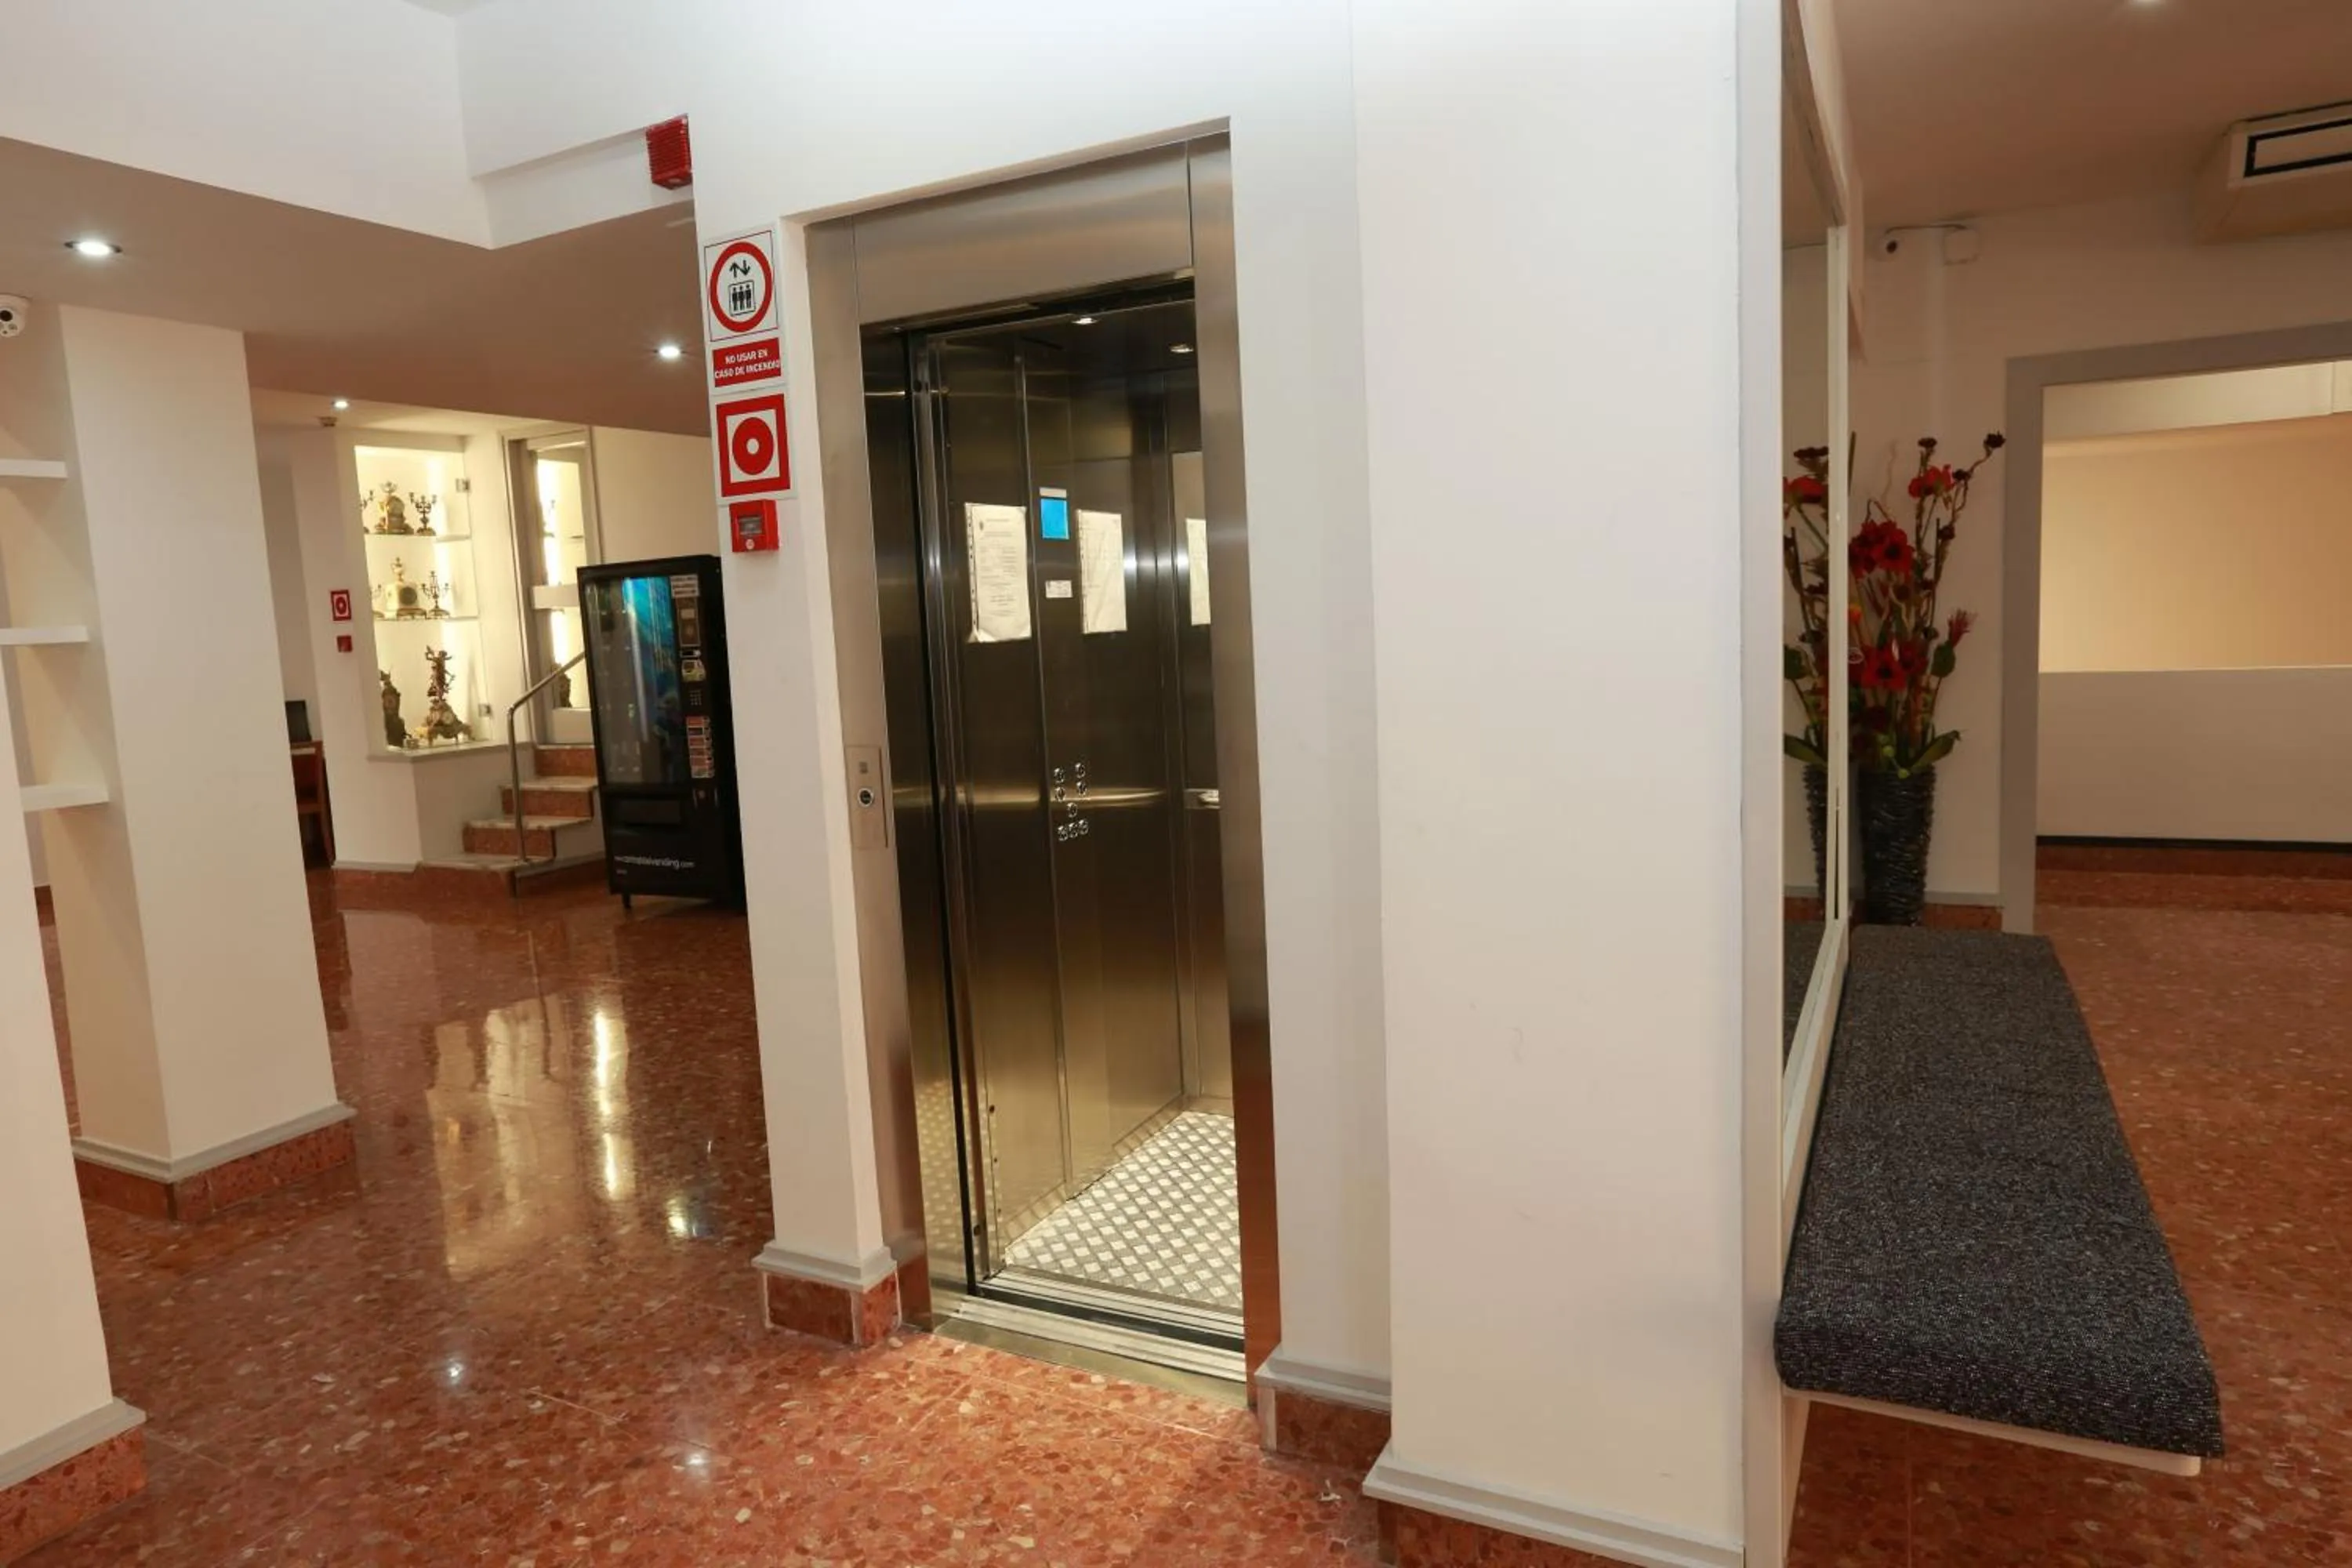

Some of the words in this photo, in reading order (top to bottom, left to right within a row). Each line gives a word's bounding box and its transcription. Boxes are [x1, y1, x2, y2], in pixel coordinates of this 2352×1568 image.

[725, 355, 735, 364] NO
[737, 350, 756, 361] USAR
[757, 348, 768, 358] EN
[715, 368, 734, 379] CASO
[735, 366, 745, 376] DE
[746, 360, 779, 372] INCENDIO
